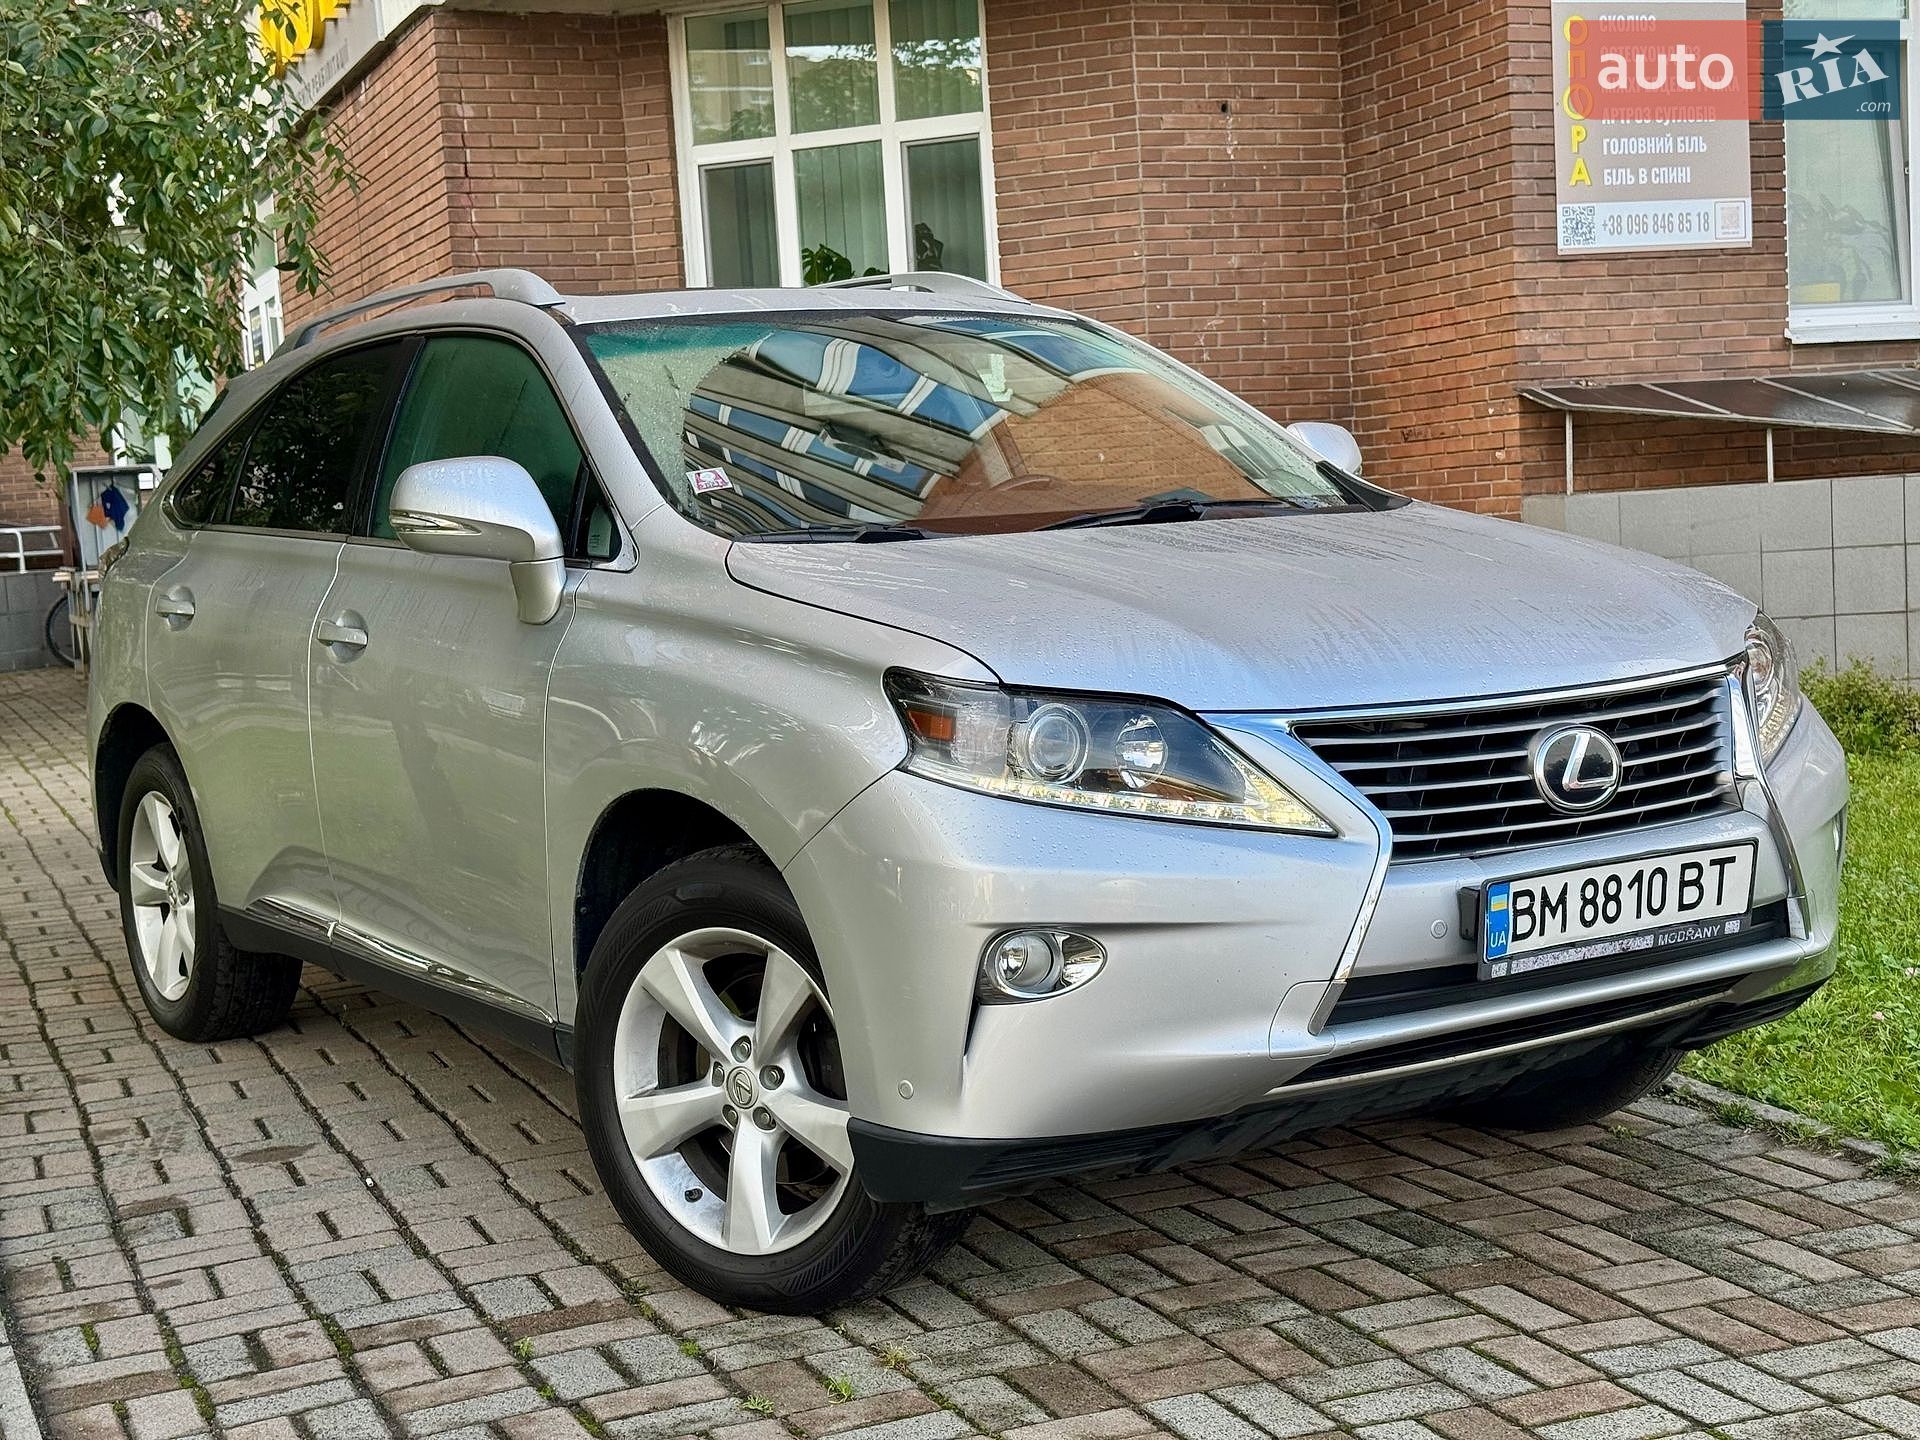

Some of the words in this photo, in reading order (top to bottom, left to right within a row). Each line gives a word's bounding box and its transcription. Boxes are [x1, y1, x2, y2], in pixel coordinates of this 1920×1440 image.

[1599, 14, 1656, 32] СКОЛІОЗ
[1601, 106, 1651, 125] АРТРОЗ
[1655, 105, 1717, 126] СУГЛОБІВ
[1602, 133, 1673, 156] ГОЛОВНИЙ
[1677, 136, 1707, 154] БІЛЬ
[1603, 167, 1635, 186] БІЛЬ
[1638, 167, 1648, 185] В
[1651, 166, 1692, 185] СПИНІ
[1602, 214, 1623, 236] +38
[1626, 213, 1649, 235] 096
[1652, 212, 1674, 234] 846
[1678, 212, 1692, 233] 85
[1697, 211, 1710, 233] 18
[1511, 882, 1568, 942] BM
[1579, 866, 1668, 928] 8810
[1677, 856, 1737, 912] BT
[1490, 932, 1507, 948] UA
